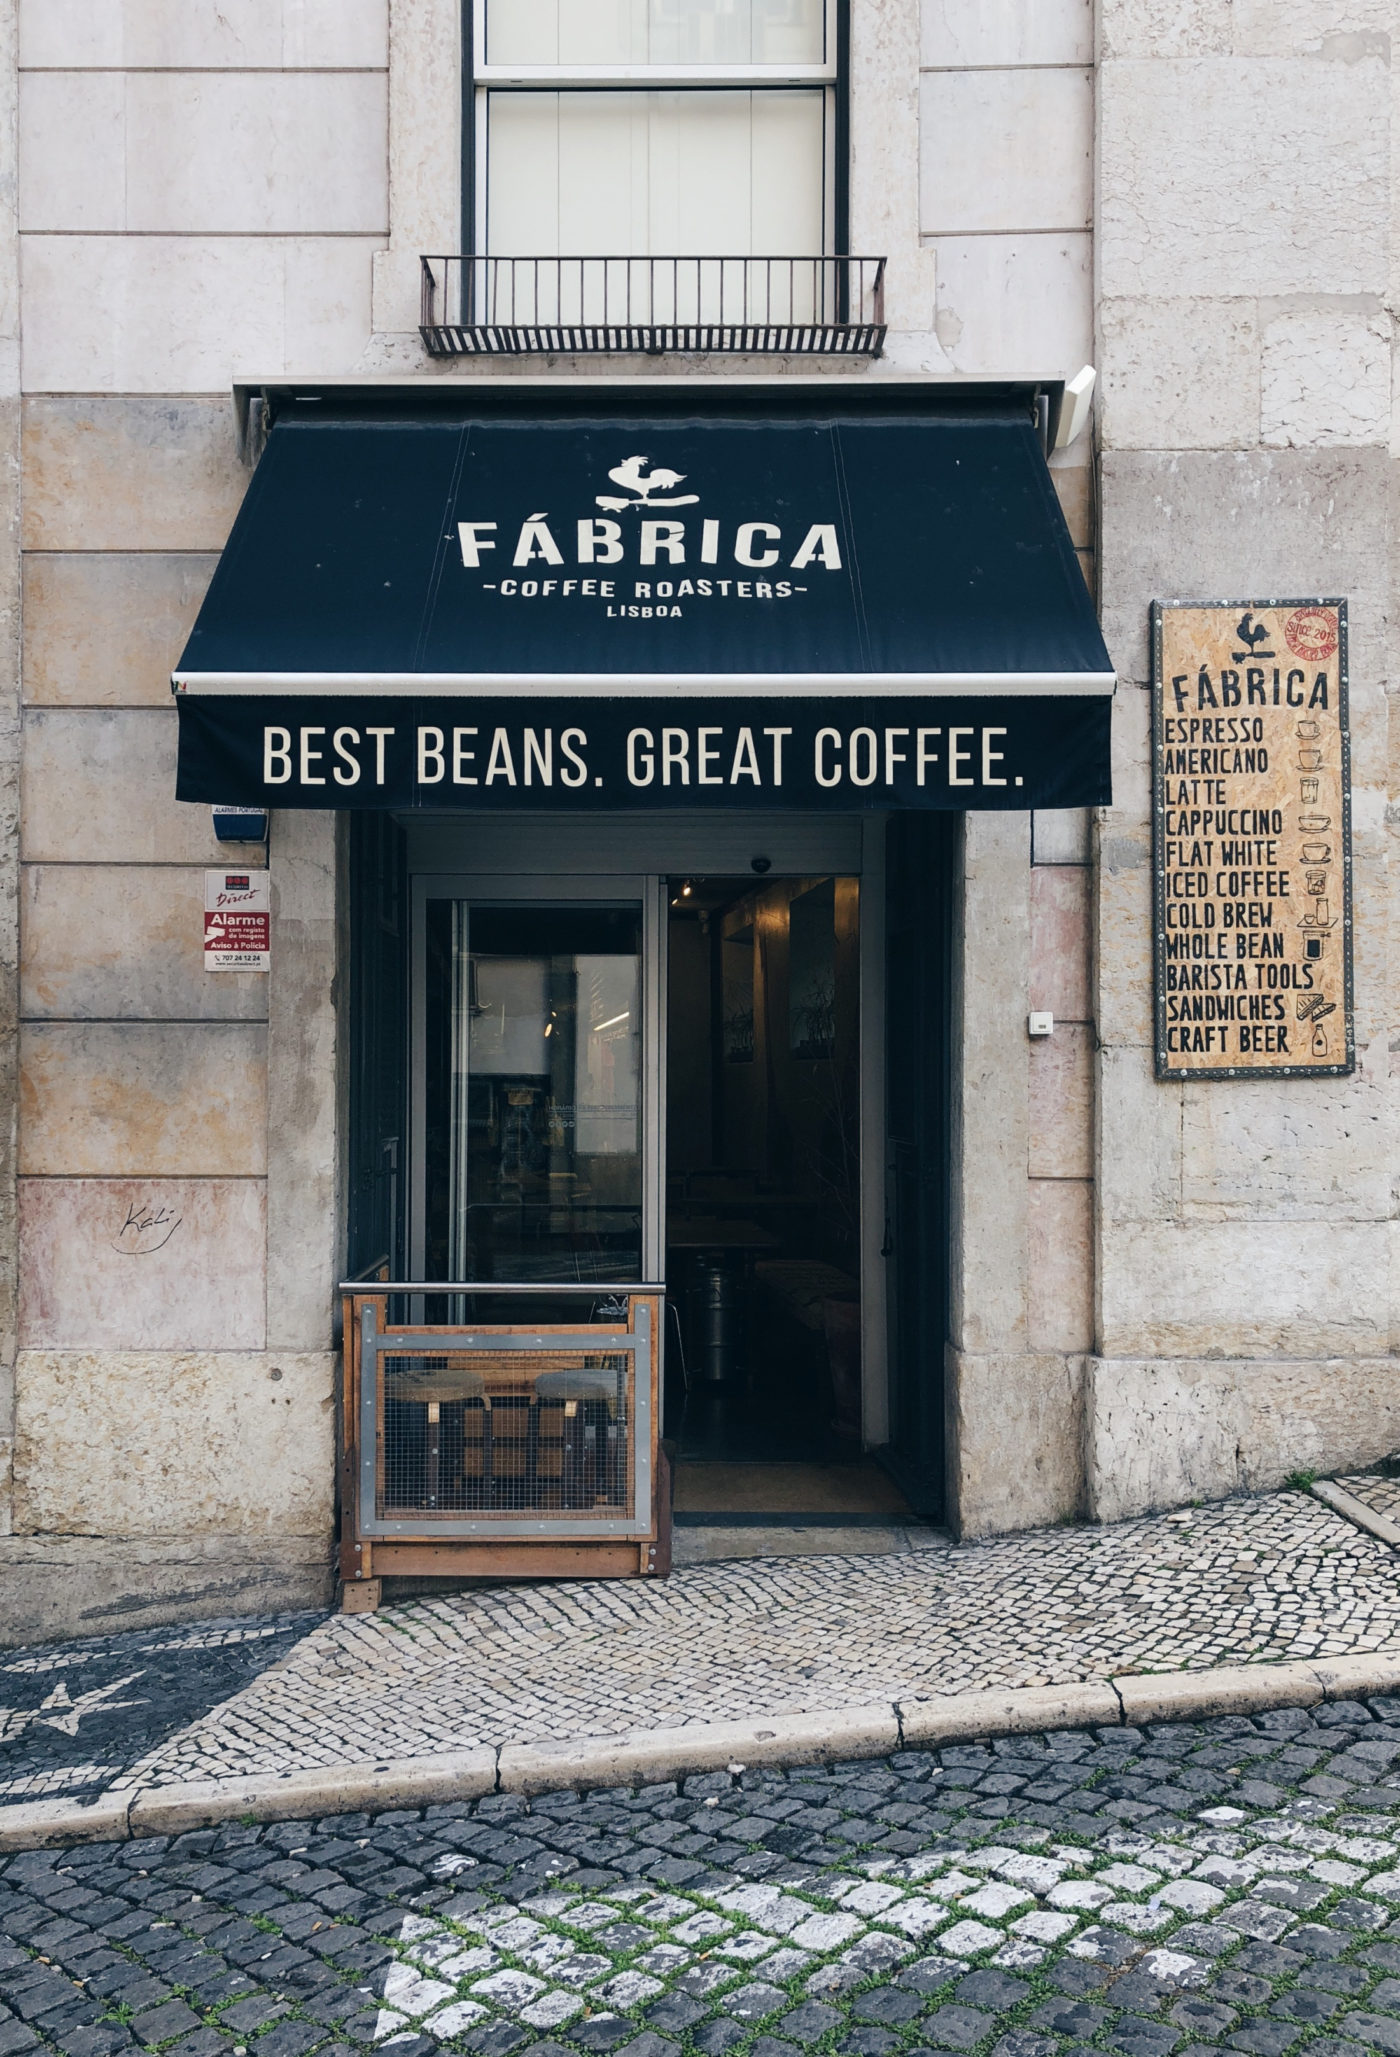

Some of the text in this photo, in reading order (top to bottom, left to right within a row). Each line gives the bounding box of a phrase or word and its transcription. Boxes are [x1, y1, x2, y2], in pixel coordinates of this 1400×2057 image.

[457, 512, 842, 570] FÁBRICA
[606, 604, 683, 618] LISBOA
[1313, 628, 1337, 643] 2015
[1171, 663, 1328, 712] FÁBRICA
[1165, 717, 1263, 744] ESPRESSO
[262, 726, 1024, 787] BEST BEANS. GREAT COFFEE.
[1165, 748, 1268, 774] AMERICANO
[1165, 779, 1226, 805] LATTE
[1165, 809, 1282, 836] CAPPUCCINO
[1166, 840, 1277, 867] FLAT WHITE
[216, 888, 261, 907] Direct
[1166, 871, 1290, 898] ICED COFFEE
[210, 913, 266, 926] Alarme
[1166, 902, 1273, 929] COLD BREW
[210, 941, 233, 949] Aviso
[239, 933, 265, 941] imagens
[1165, 932, 1284, 960] WHOLE BEAN
[1166, 963, 1314, 991] BARISTA TOOLS
[1167, 994, 1286, 1021] SANDWICHES
[1167, 1026, 1290, 1053] CRAFT BEER
